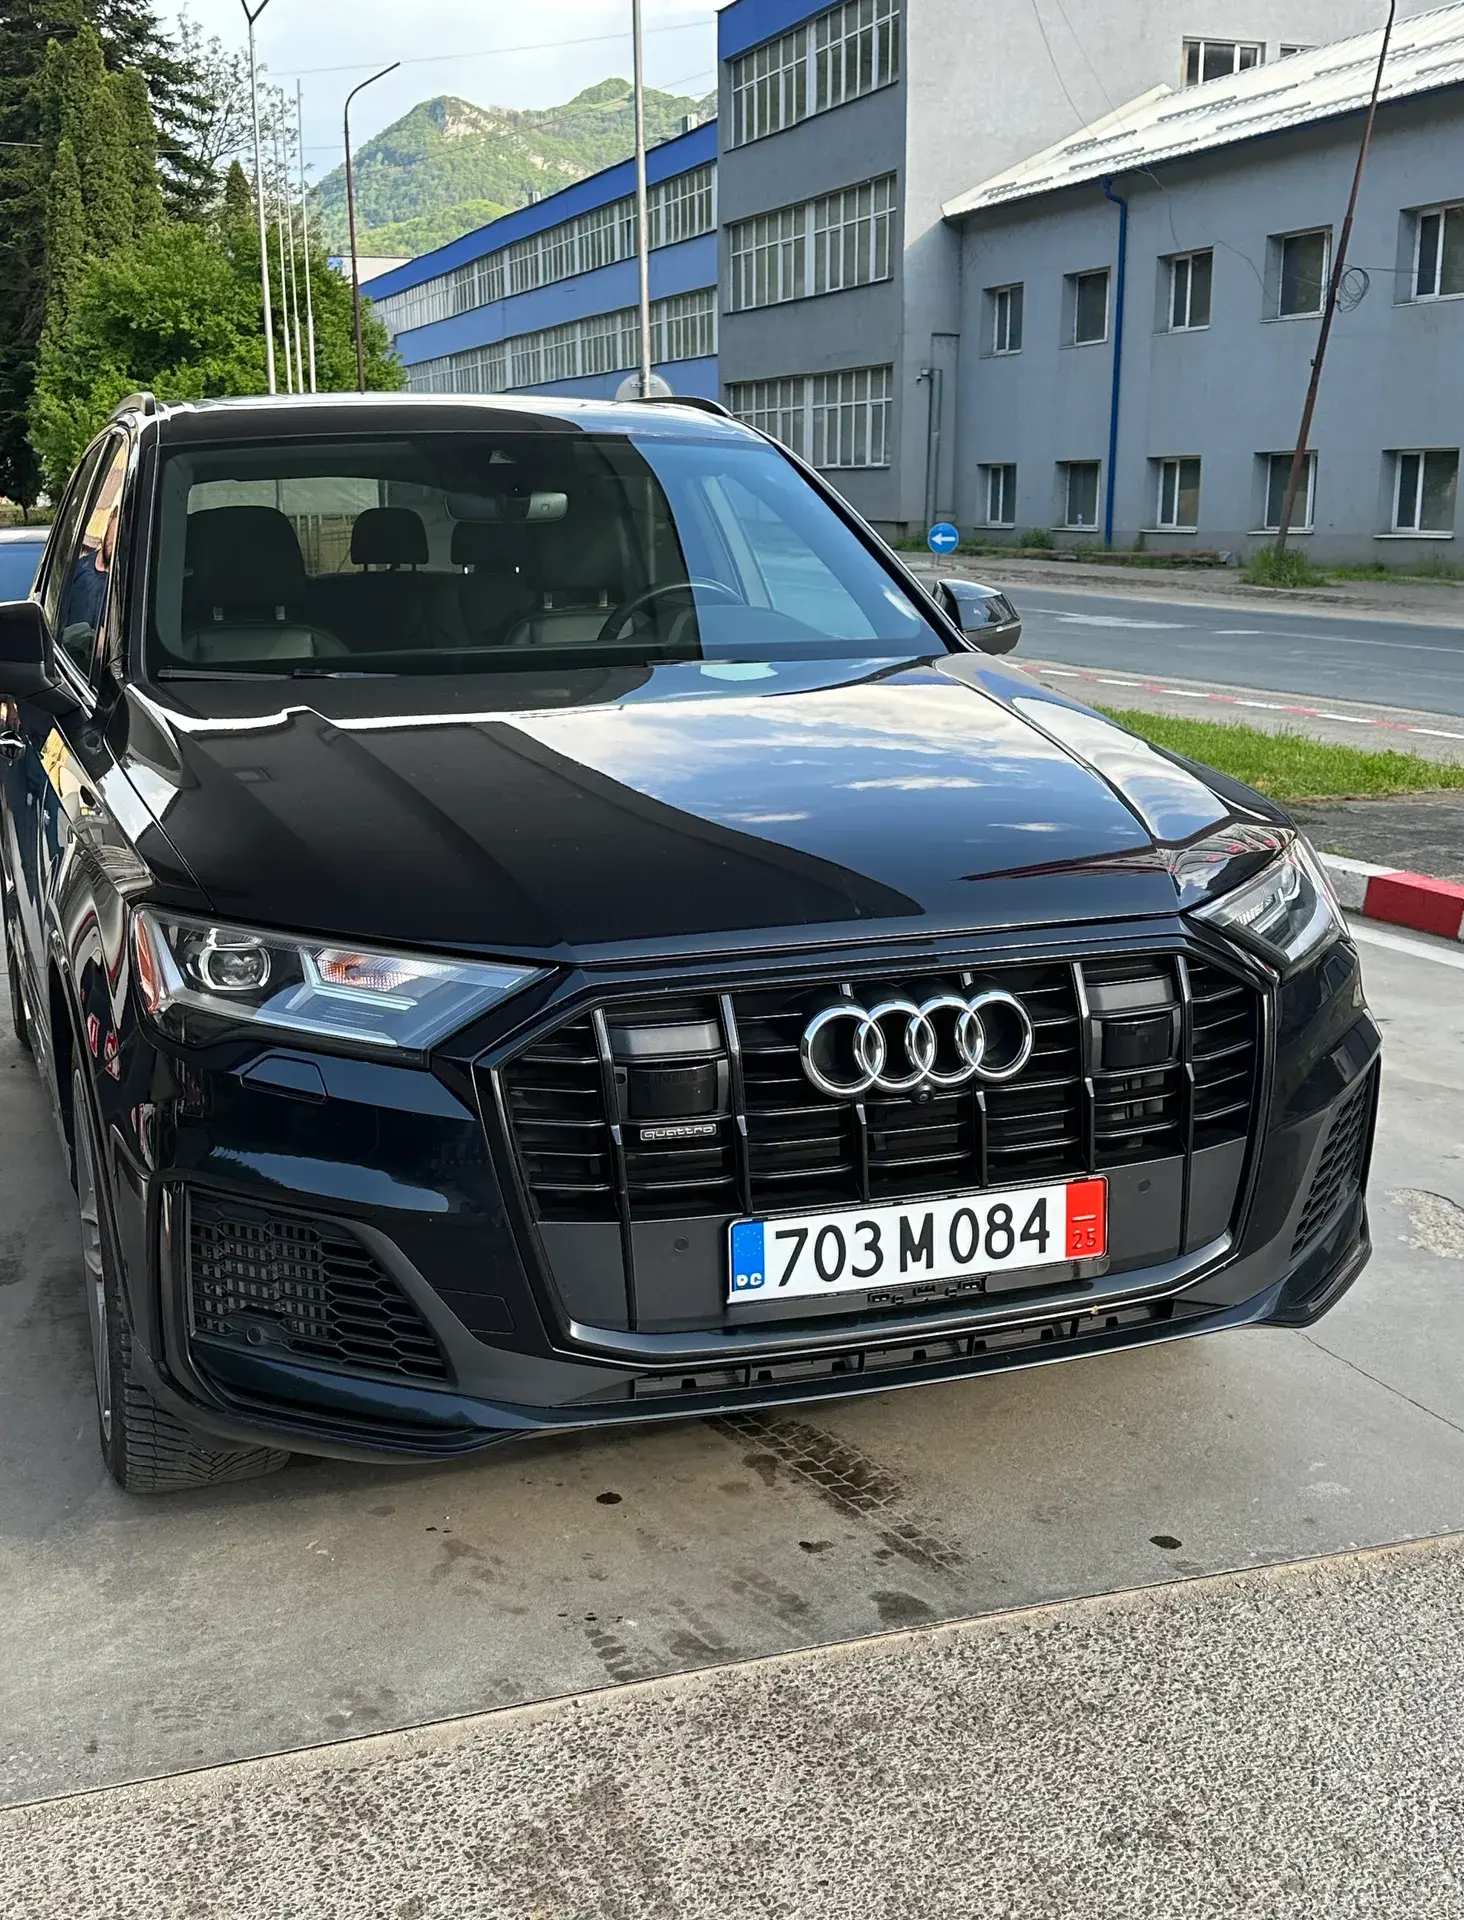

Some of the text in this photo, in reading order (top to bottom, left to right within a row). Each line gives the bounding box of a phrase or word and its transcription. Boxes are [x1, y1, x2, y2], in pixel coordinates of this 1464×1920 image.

[644, 1126, 714, 1139] quattro
[774, 1197, 1050, 1288] 703 M 084
[1071, 1228, 1097, 1250] 25
